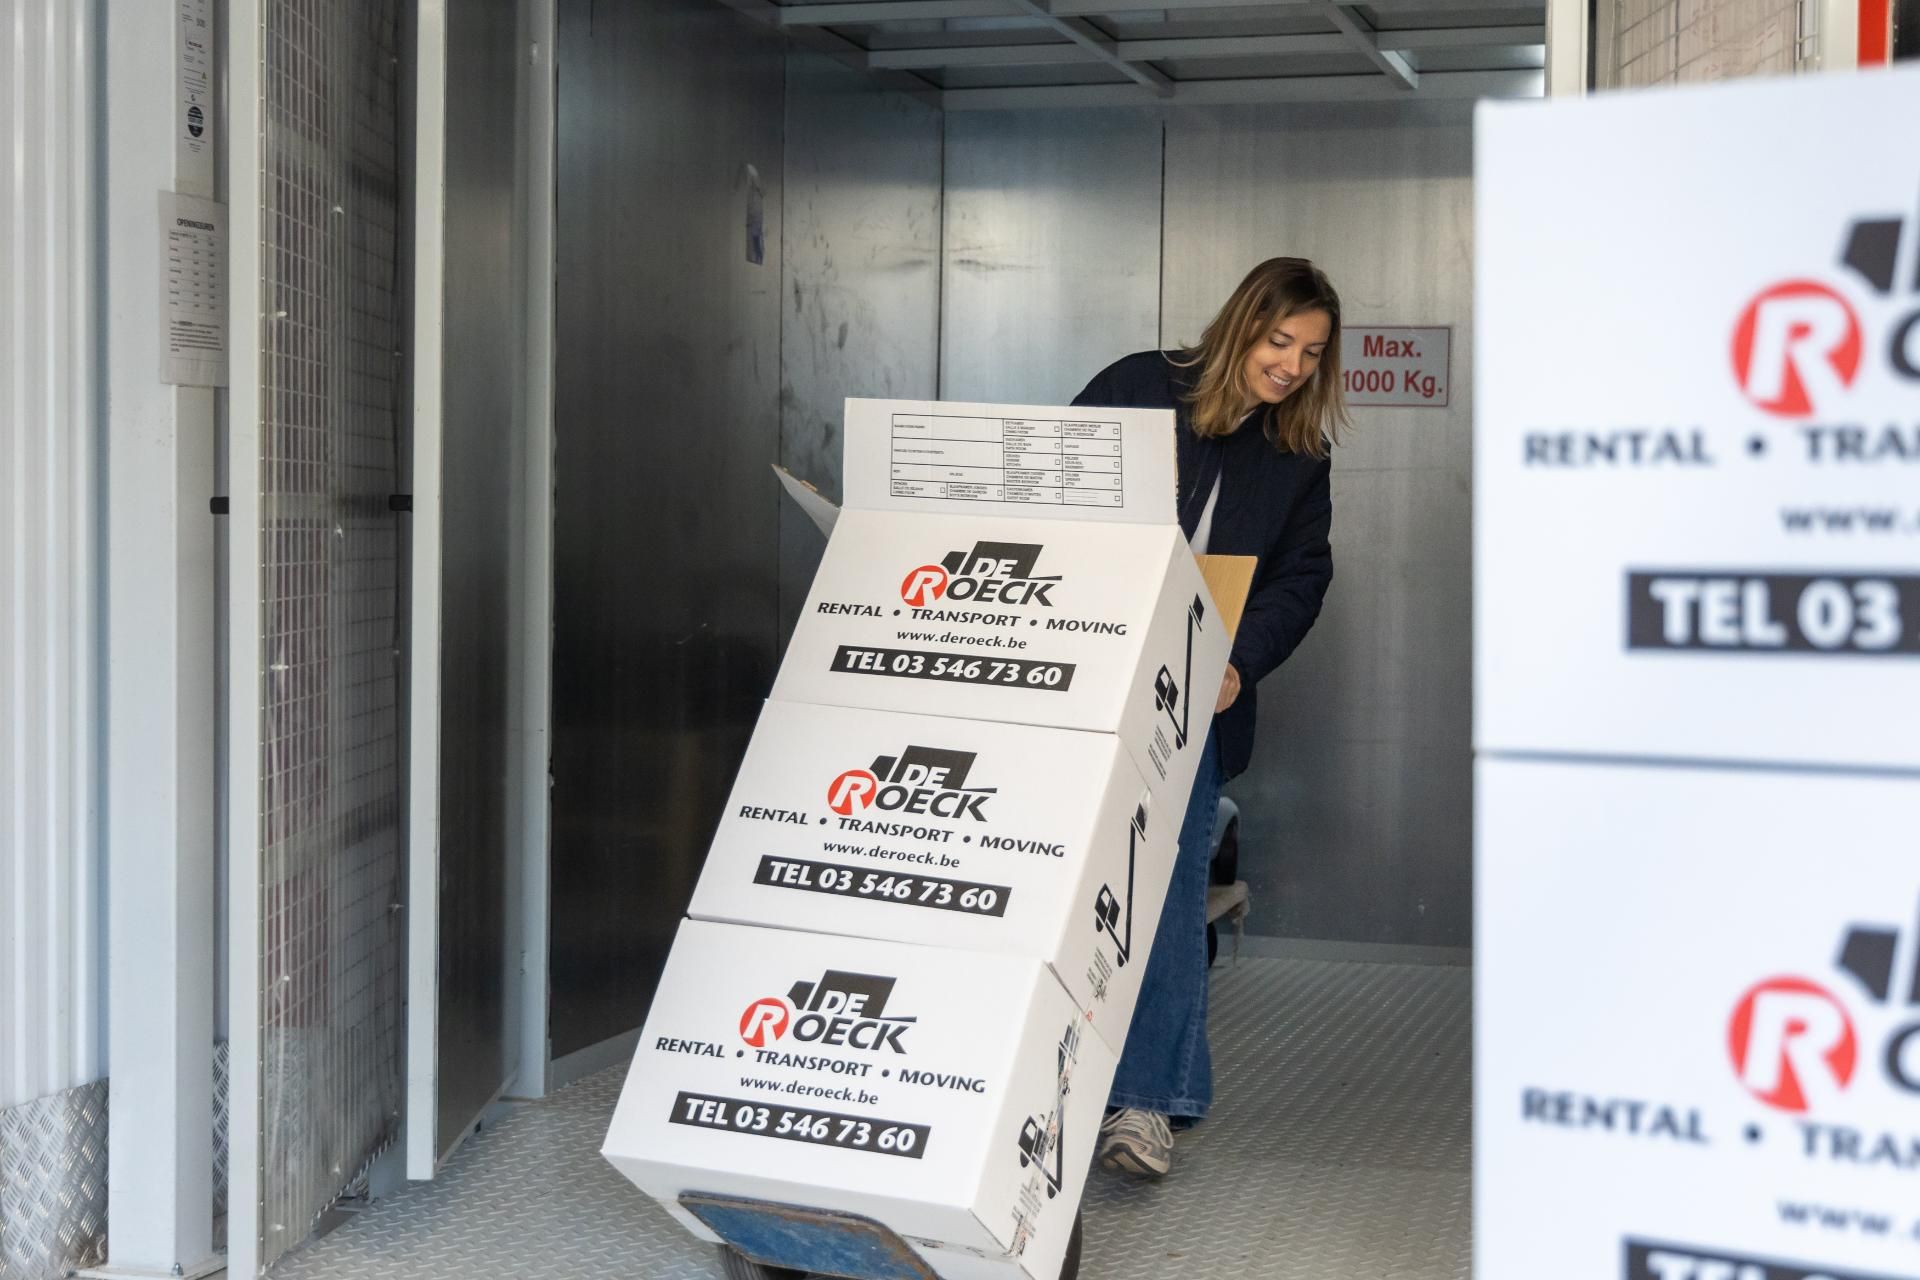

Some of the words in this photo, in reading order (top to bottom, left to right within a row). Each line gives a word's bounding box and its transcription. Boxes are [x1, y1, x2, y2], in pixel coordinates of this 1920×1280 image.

[1363, 335, 1421, 357] Max.
[1343, 369, 1394, 392] 1000
[1404, 369, 1442, 398] Kg.
[1524, 428, 1712, 467] RENTAL
[1799, 423, 1920, 463] TRA
[973, 557, 1018, 578] DE
[902, 567, 1056, 607] ROECK
[817, 602, 883, 617] RENTAL
[911, 608, 1021, 627] TRANSPORT
[1046, 618, 1128, 635] MOVING
[1649, 578, 1788, 647] TEL
[1797, 580, 1903, 649] 03
[897, 630, 1027, 649] www.deroeck.be
[845, 650, 886, 671] TEL
[892, 654, 925, 674] 03
[930, 657, 981, 679] 546
[986, 662, 1020, 682] 73
[1026, 666, 1062, 686] 60
[901, 764, 951, 788] DE
[828, 771, 991, 822] ROECK
[739, 805, 808, 825] RENTAL
[838, 817, 954, 843] TRANSPORT
[979, 835, 1066, 858] MOVING
[823, 841, 961, 868] www.deroeck.be
[770, 861, 812, 886] TEL
[818, 867, 853, 891] 03
[858, 873, 912, 899] 546
[918, 881, 952, 904] 73
[959, 888, 998, 910] 60
[819, 990, 870, 1017] DE
[741, 999, 912, 1055] ROECK
[655, 1037, 726, 1059] RENTAL
[755, 1049, 873, 1078] TRANSPORT
[898, 1069, 986, 1094] MOVING
[739, 1076, 879, 1106] www.deroeck.be
[685, 1098, 729, 1125] TEL
[734, 1105, 770, 1130] 03
[775, 1112, 830, 1140] 546
[835, 1120, 870, 1145] 73
[877, 1127, 916, 1152] 60
[1523, 1087, 1709, 1145] RENTAL
